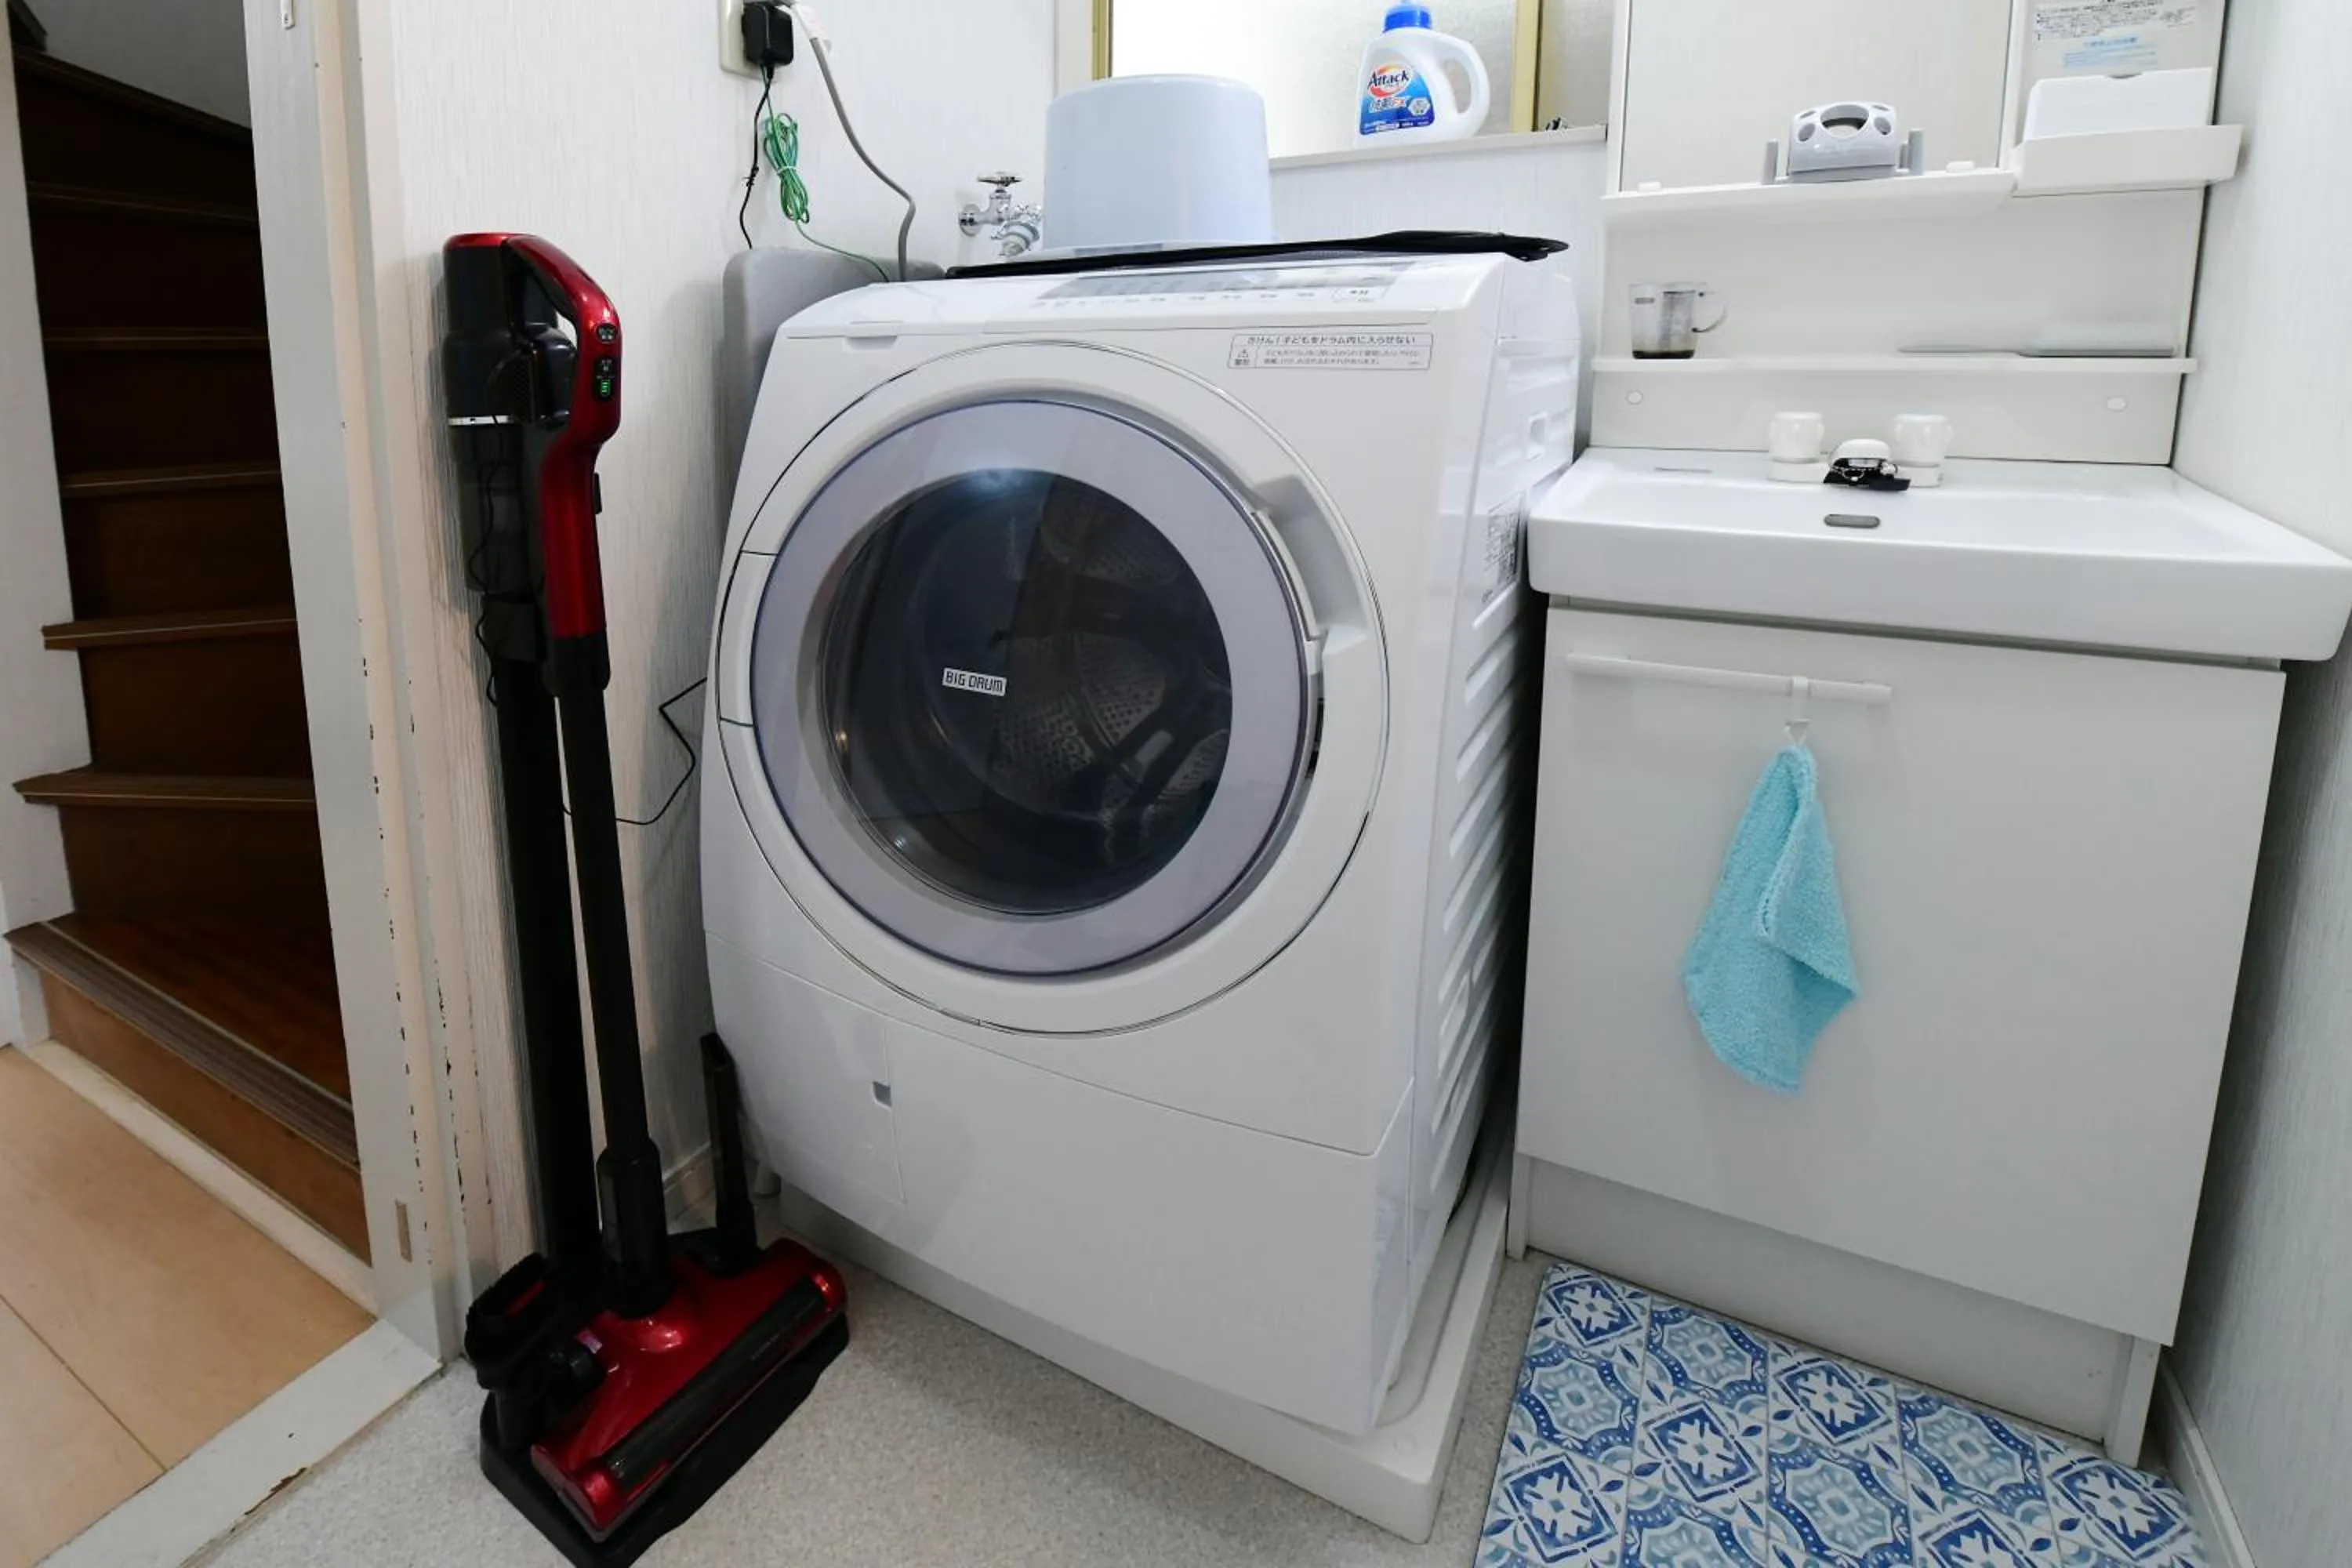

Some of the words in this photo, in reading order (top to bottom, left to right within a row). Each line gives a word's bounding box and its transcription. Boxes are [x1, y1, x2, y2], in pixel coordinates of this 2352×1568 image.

[1368, 71, 1409, 87] Attack
[946, 671, 966, 686] BIG
[969, 675, 1003, 692] DRUM
